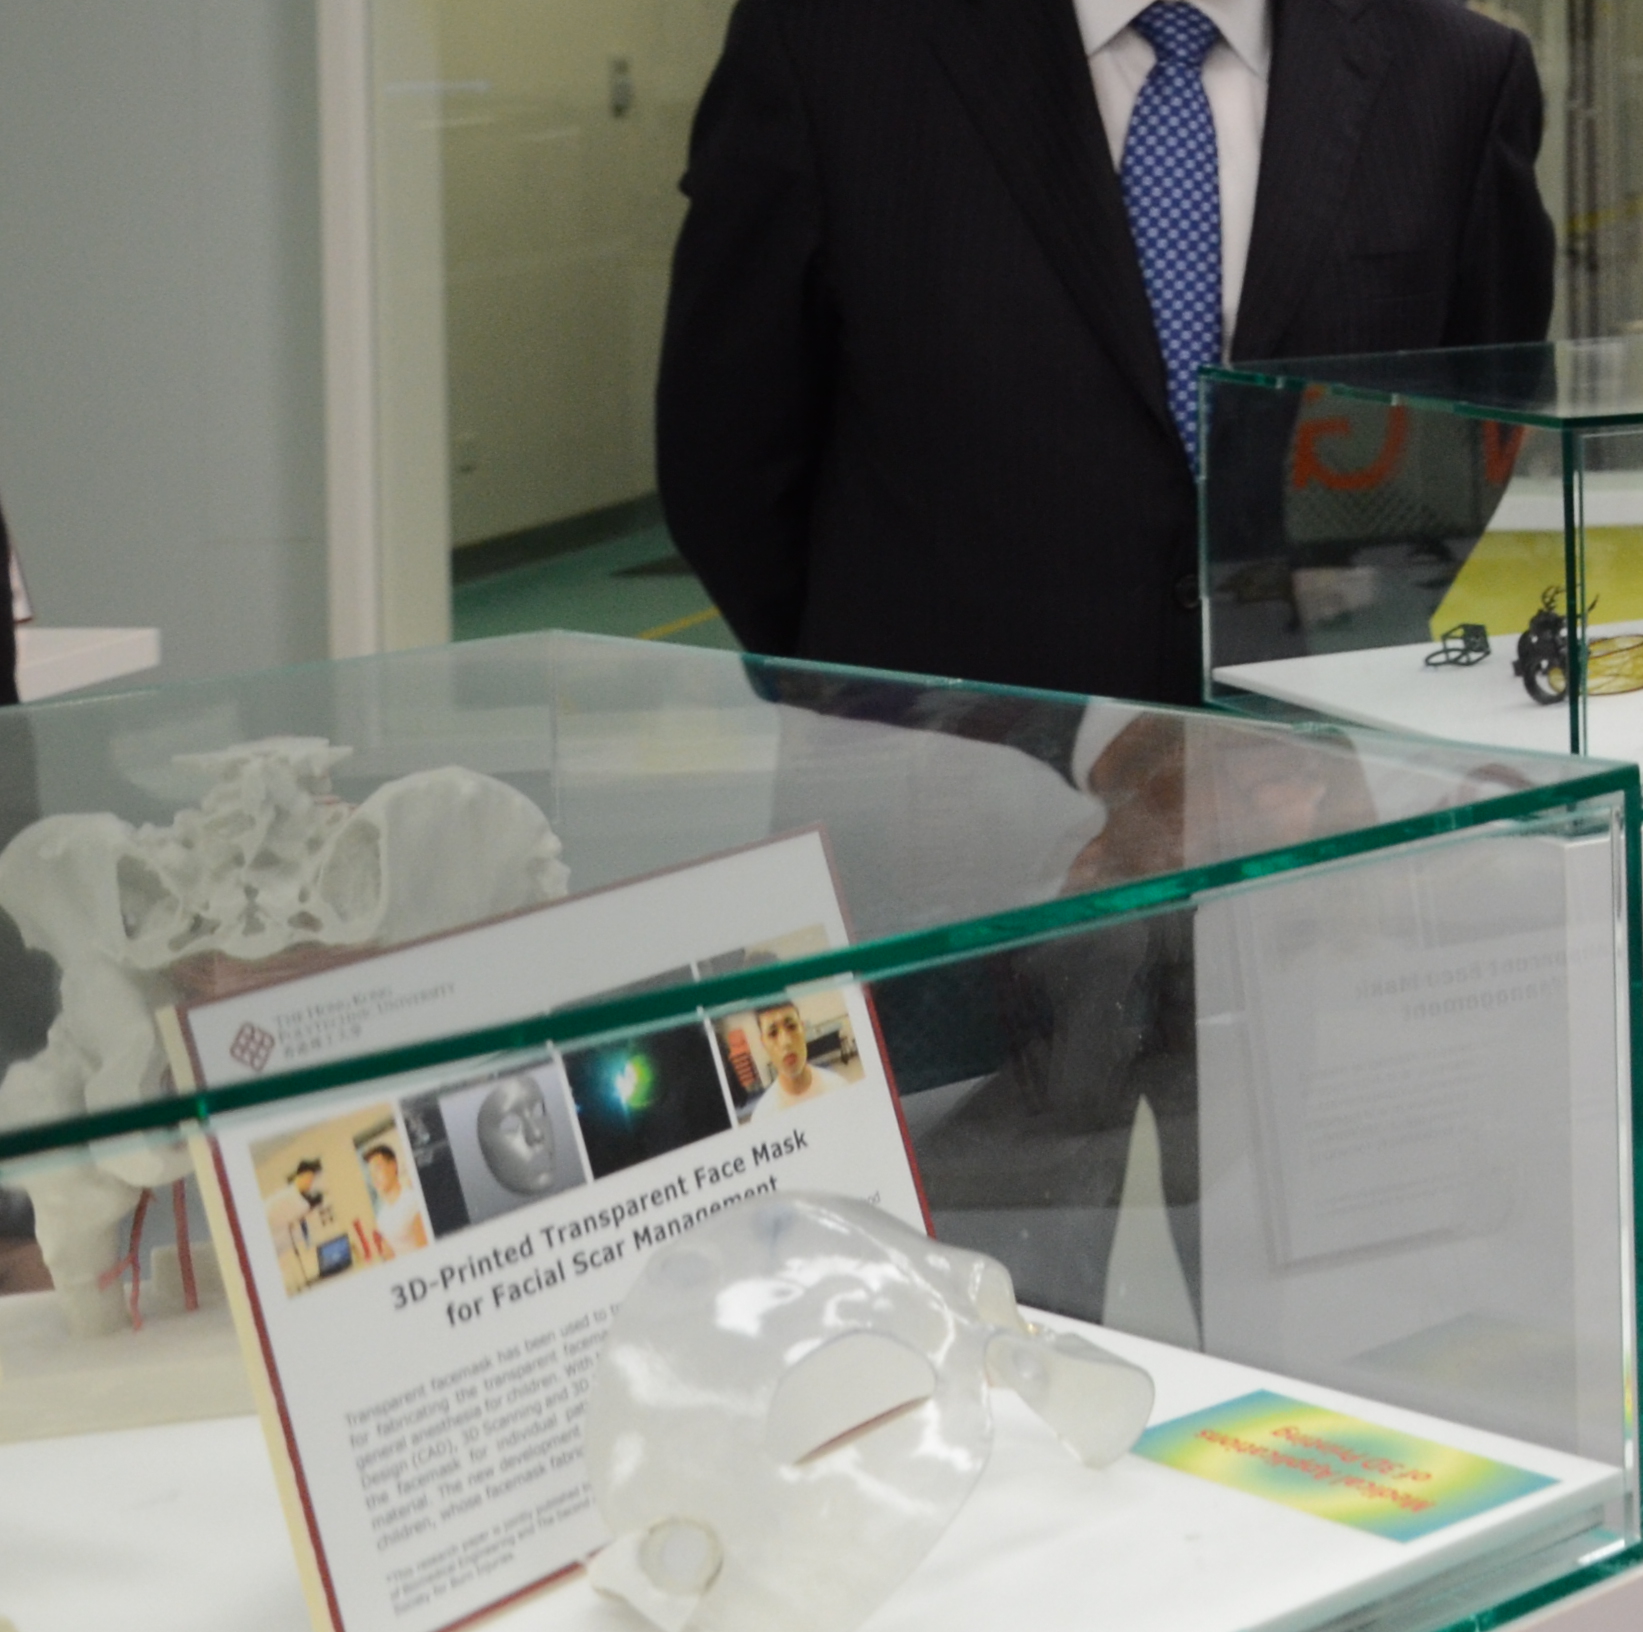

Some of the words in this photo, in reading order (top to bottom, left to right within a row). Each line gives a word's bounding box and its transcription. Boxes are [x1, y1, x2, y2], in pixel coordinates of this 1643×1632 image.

[389, 1234, 535, 1312] 3D-Printed
[539, 1173, 690, 1252] Transparent
[692, 1151, 746, 1190] Face
[750, 1125, 809, 1166] Mask
[444, 1291, 485, 1327] for
[490, 1258, 567, 1309] Facial
[570, 1234, 628, 1276] Scar
[496, 1342, 520, 1364] has
